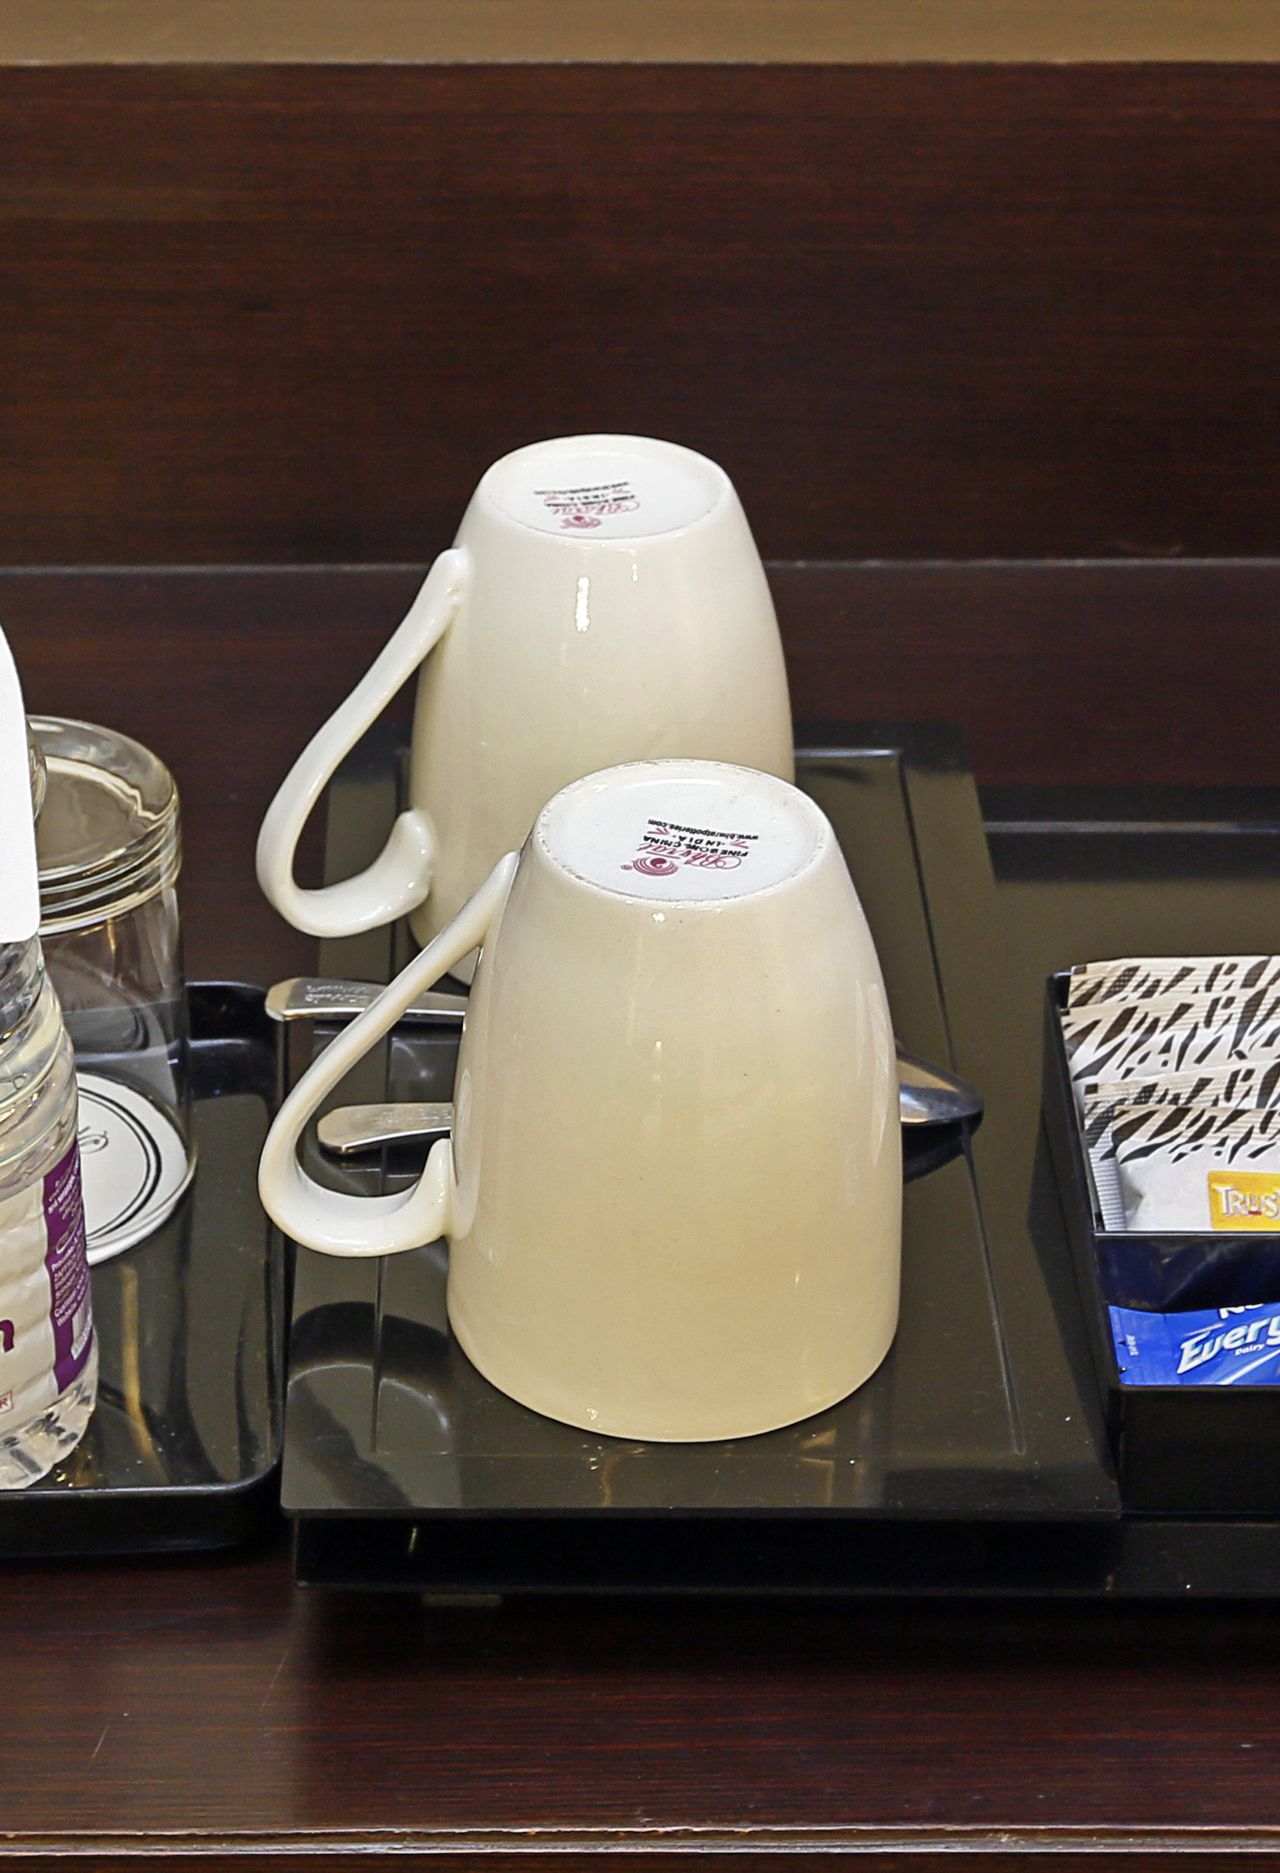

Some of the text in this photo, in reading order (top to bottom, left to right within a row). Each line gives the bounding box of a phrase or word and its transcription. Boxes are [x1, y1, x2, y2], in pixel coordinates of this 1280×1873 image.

[643, 835, 681, 848] CHINA
[721, 849, 748, 857] FINE
[1235, 1343, 1265, 1356] Dairy
